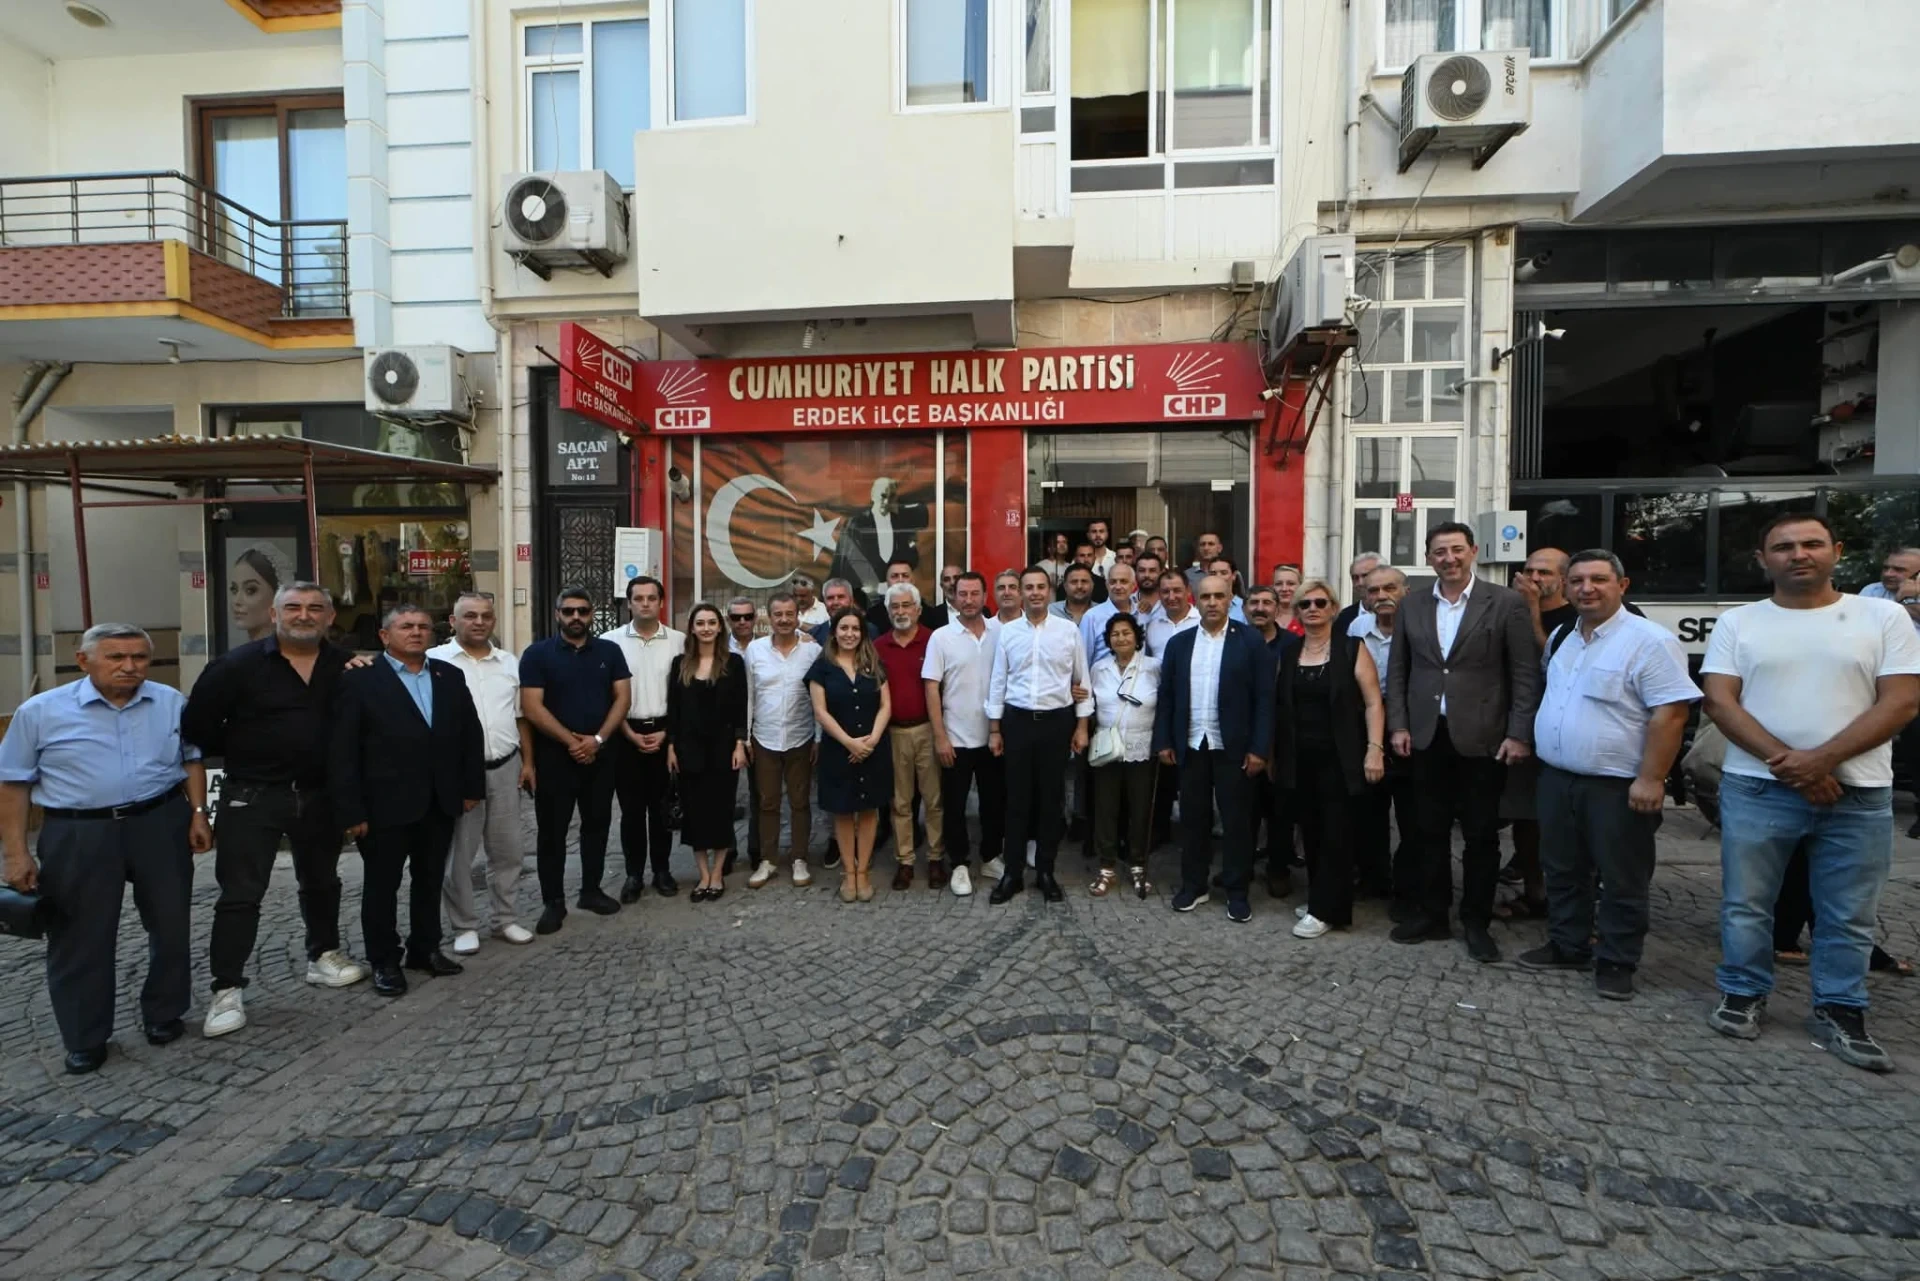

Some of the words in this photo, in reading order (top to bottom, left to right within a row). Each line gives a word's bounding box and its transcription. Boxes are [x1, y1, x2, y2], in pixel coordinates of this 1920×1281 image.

[604, 356, 631, 386] CHP
[729, 361, 915, 400] CUMHURİYET
[930, 358, 1006, 394] HALK
[1022, 354, 1135, 392] PARTİSİ
[595, 381, 618, 404] ERDEK
[793, 406, 866, 427] ERDEK
[874, 404, 921, 428] İLÇE
[928, 396, 1065, 425] BAŞKANLIĞI
[1168, 396, 1222, 415] CHP
[659, 410, 707, 427] CHP
[557, 441, 608, 456] SAÇAN
[566, 457, 600, 470] APT.
[519, 547, 528, 556] 13
